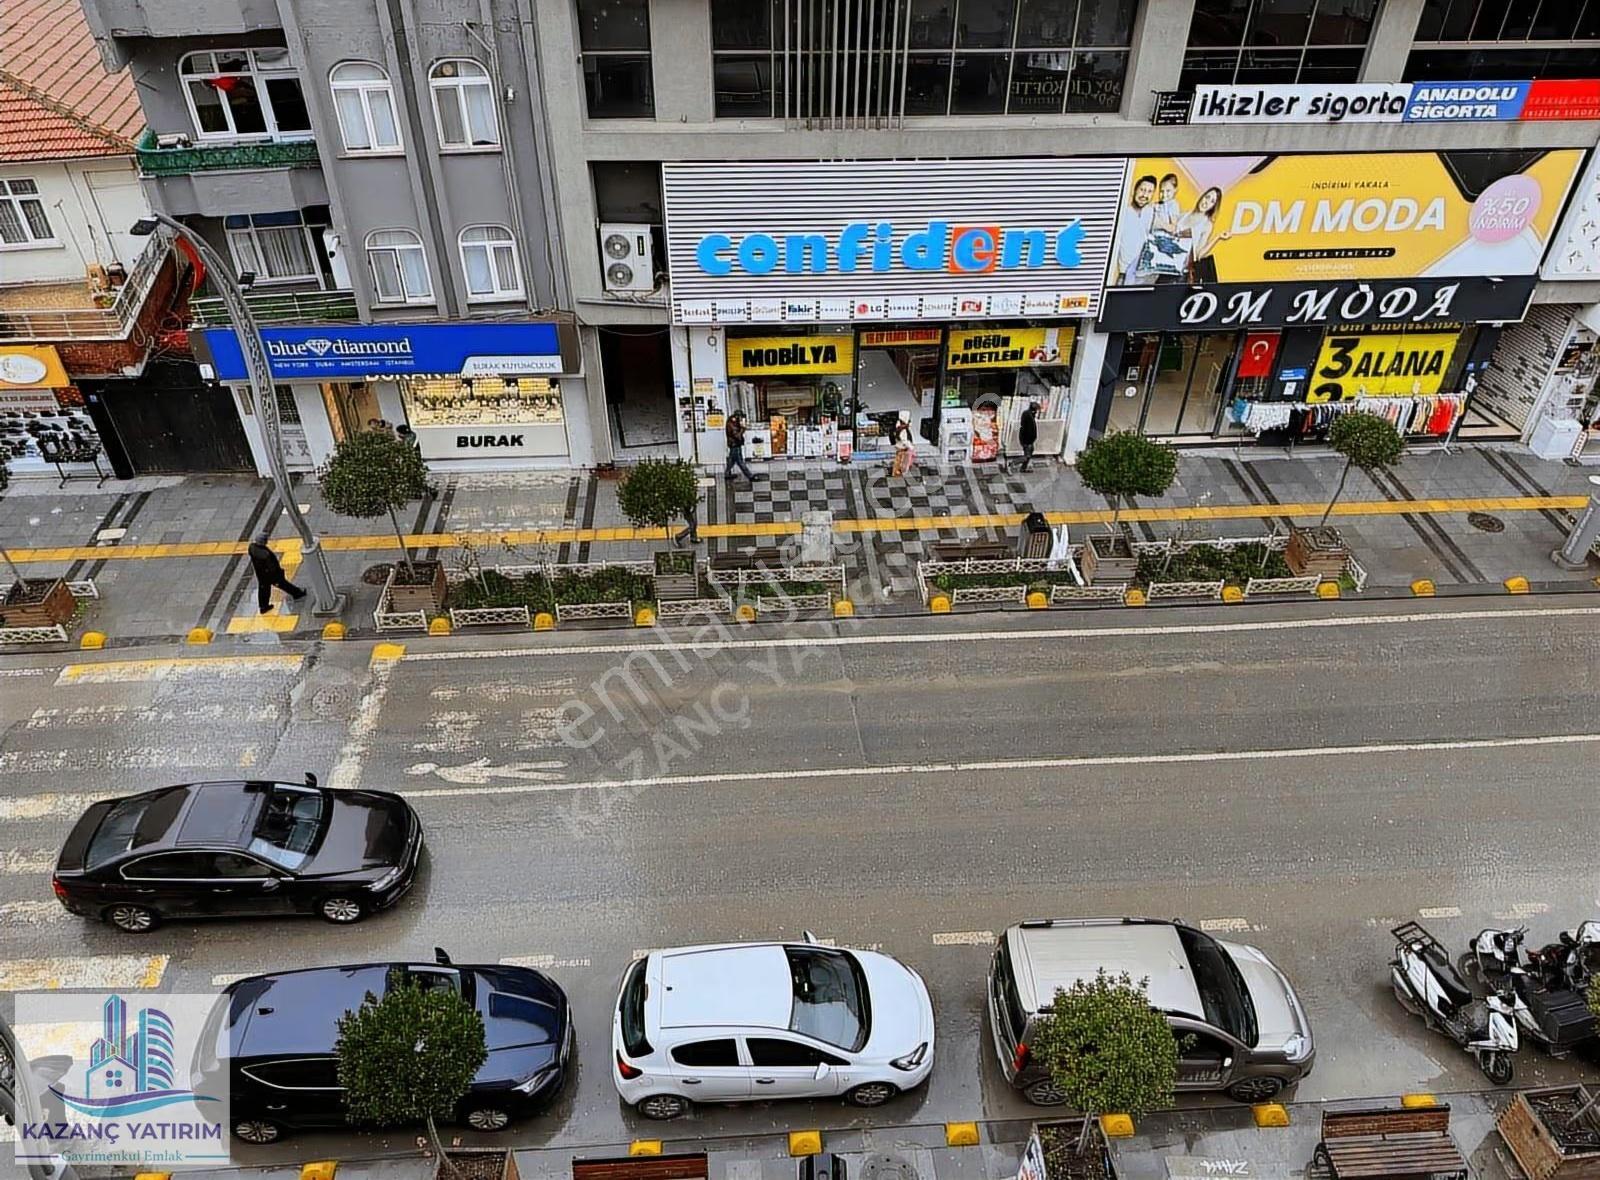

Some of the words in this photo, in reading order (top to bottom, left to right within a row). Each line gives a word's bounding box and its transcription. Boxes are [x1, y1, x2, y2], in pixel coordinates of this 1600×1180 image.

[1414, 87, 1519, 102] ANADOLU
[1199, 89, 1300, 117] ikizler
[1308, 92, 1407, 122] sigorta
[1408, 101, 1498, 119] SİGORTA
[1354, 180, 1390, 189] YAKALA
[1231, 199, 1305, 235] DM
[1311, 197, 1446, 234] MODA
[1480, 198, 1530, 216] %50
[695, 217, 1088, 276] confident
[870, 305, 882, 313] LG
[1180, 288, 1273, 324] DM
[1286, 283, 1461, 322] MODA
[267, 340, 308, 356] blue
[332, 337, 412, 355] diamond
[742, 343, 837, 368] MOBİLYA
[473, 362, 500, 370] BURAK
[1319, 338, 1360, 381] 3
[1351, 350, 1446, 378] ALANA
[456, 434, 524, 449] BURAK
